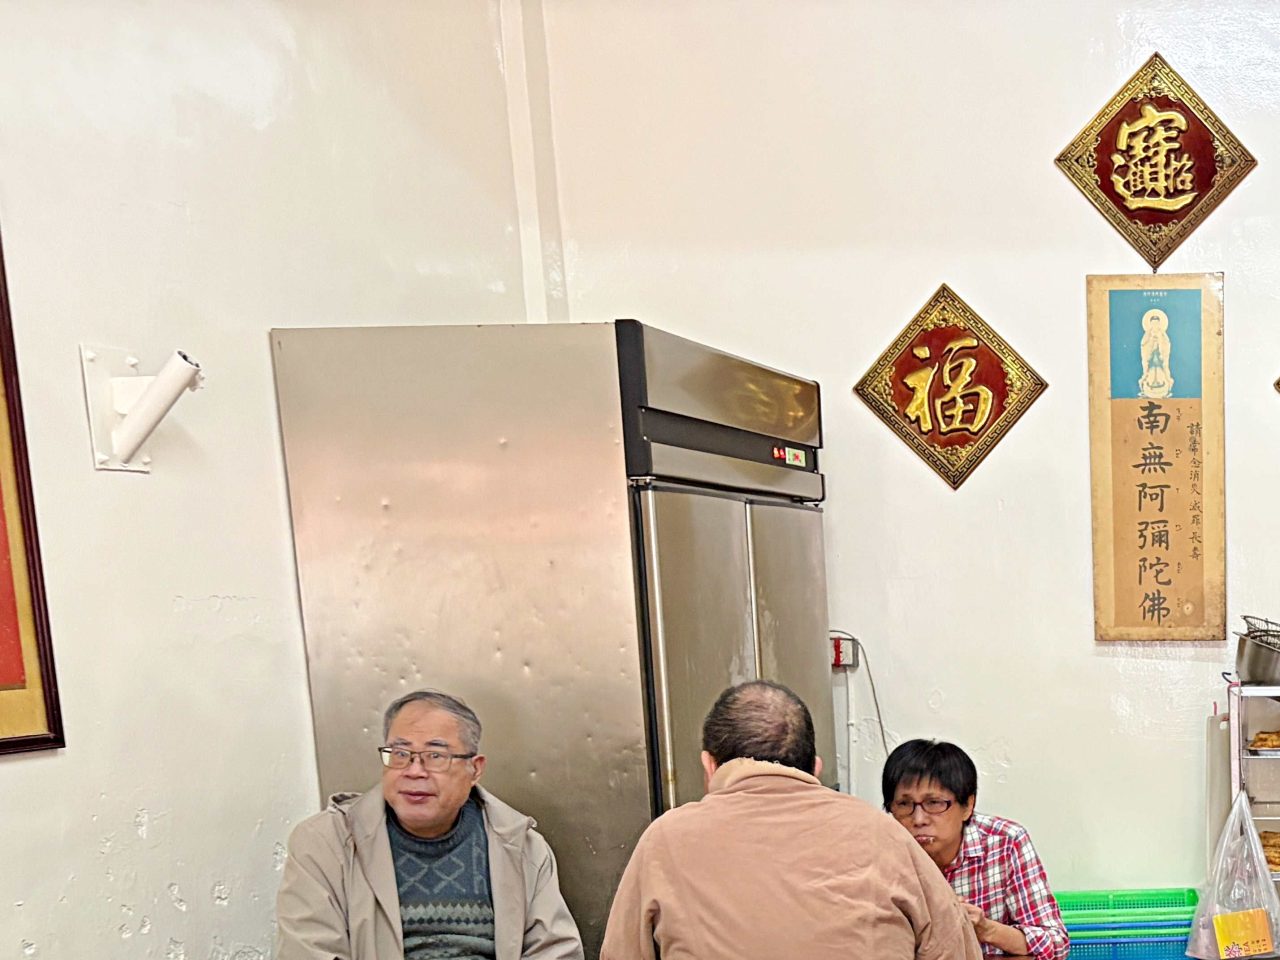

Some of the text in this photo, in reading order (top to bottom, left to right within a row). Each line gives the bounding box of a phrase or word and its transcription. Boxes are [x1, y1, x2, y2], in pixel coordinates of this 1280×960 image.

[903, 337, 993, 436] 福
[1131, 400, 1174, 626] 南無阿彌陀佛
